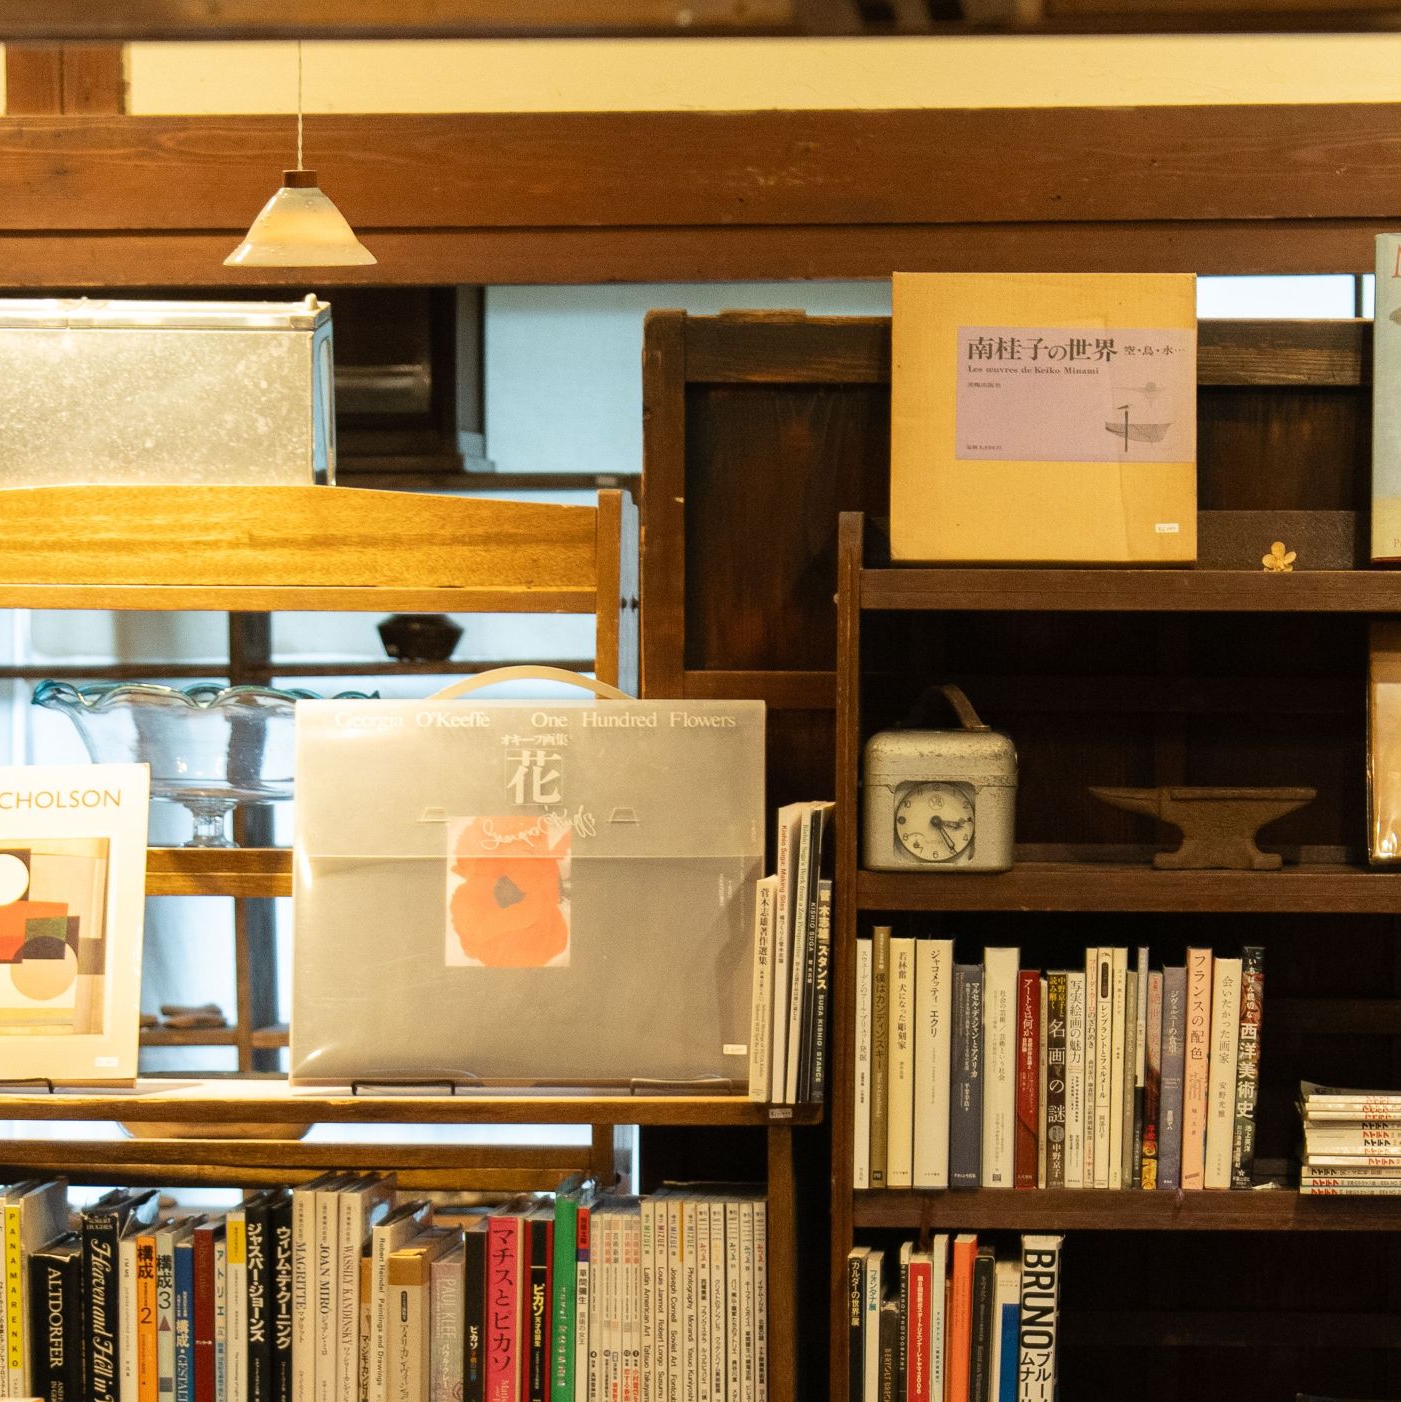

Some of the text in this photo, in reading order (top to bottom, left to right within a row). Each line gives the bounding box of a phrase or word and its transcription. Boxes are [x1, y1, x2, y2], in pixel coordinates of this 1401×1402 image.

[967, 336, 1118, 362] 南桂子の世界
[968, 365, 1100, 375] Les de Keiko Minami
[500, 734, 570, 747] オキーフ画集
[531, 711, 569, 729] One
[582, 711, 658, 729] Hundred
[669, 711, 736, 729] Flowers
[505, 749, 562, 805] 花
[780, 825, 788, 846] Kishio
[778, 868, 787, 893] Making
[778, 894, 787, 911] Sites
[816, 945, 829, 990] スタンス
[897, 983, 908, 1050] 犬になった彫刻家
[929, 949, 941, 1038] ジャコメッティ エクリ
[1022, 978, 1034, 1037] アートとは何か
[1190, 954, 1207, 1060] フランスの配色
[813, 994, 825, 1083] SUGA KISHIO STANCE
[1068, 979, 1082, 1064] 写実絵画の魅力
[1169, 990, 1180, 1056] ジヴェルニーの食卓
[1218, 976, 1234, 1064] 会いたかった画家
[1047, 1018, 1066, 1123] 名画の謎
[1098, 1004, 1107, 1098] レンブラントとフェルメール
[1236, 1021, 1258, 1119] 西洋美術史
[1217, 1081, 1227, 1119] 安野光雅
[1051, 1143, 1062, 1178] 中野京子
[378, 1237, 386, 1263] Robert
[657, 1225, 665, 1248] MIZUE
[9, 1213, 19, 1368] PANAMARENKO
[136, 1245, 154, 1325] 構成 2
[217, 1250, 225, 1316] アトリエ
[276, 1226, 292, 1350] ウィレム・デ・クーニング
[296, 1242, 306, 1310] MAGRITTE
[319, 1243, 332, 1315] JOAN MIRÓ
[341, 1245, 354, 1346] WASSILY KANDINSKY
[378, 1264, 386, 1294] Heindel
[492, 1228, 515, 1372] マチスとピカソ
[533, 1283, 545, 1316] ピカソ
[669, 1266, 678, 1323] Joseph Cornell
[685, 1266, 694, 1310] Photography
[868, 1269, 877, 1312] フォンタナ展
[1022, 1249, 1056, 1350] BRUNO
[47, 1267, 63, 1369] ALTDORFER
[90, 1238, 114, 1392] Heaven and Hell in
[377, 1298, 386, 1334] Paintings
[470, 1325, 479, 1350] ピカソ
[643, 1345, 651, 1369] Tatsuo
[657, 1344, 665, 1367] Longo
[670, 1329, 678, 1353] Soviet
[883, 1347, 892, 1381] BERTOLT
[376, 1350, 384, 1386] Drawings
[685, 1369, 694, 1402] Kuniyoshi
